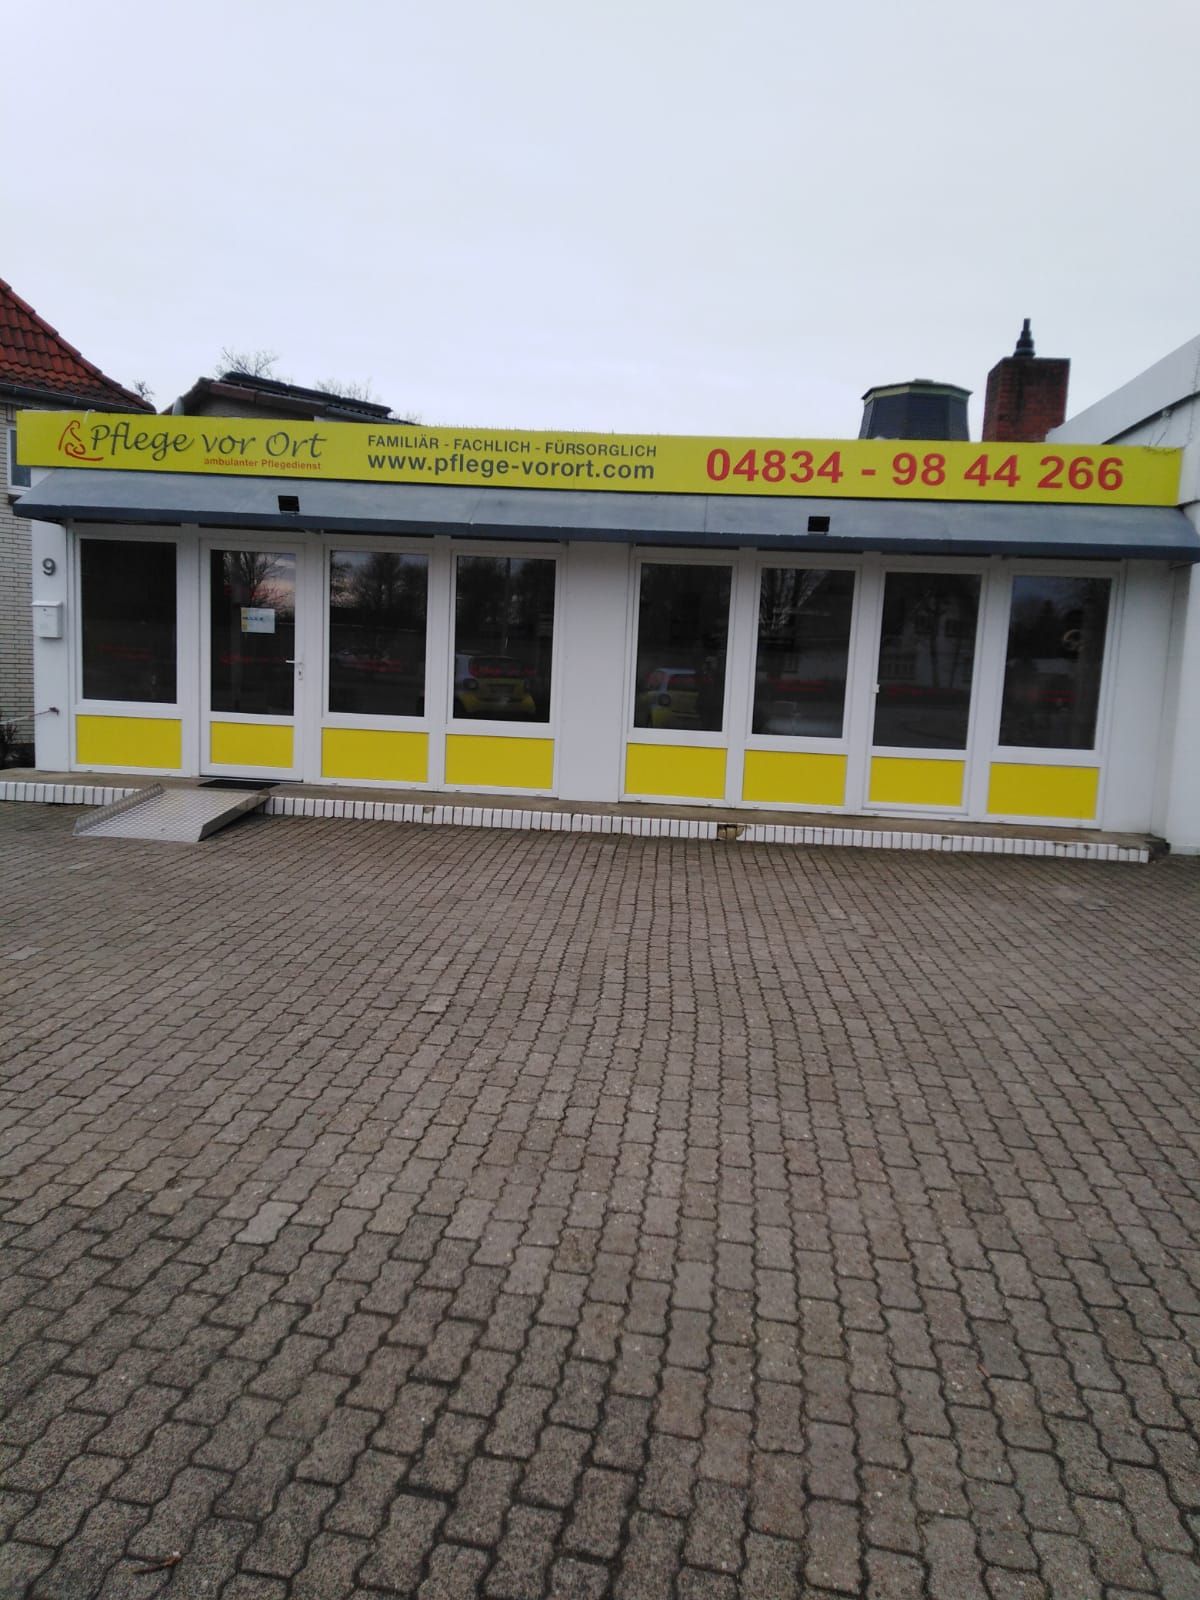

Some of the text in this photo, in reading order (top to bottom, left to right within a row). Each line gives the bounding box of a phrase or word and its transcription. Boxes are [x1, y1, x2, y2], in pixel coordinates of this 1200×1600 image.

[90, 421, 327, 461] Pflege vor Ort
[368, 434, 439, 449] FAMILIÄR
[453, 438, 530, 453] FACHLICH
[545, 439, 657, 457] FÜRSORGLICH
[204, 457, 321, 470] ambulanter Pflegedienst
[368, 453, 655, 479] www.pflege-vorort.com
[706, 448, 1124, 490] 04834 - 98 44 266
[42, 558, 56, 576] 9
